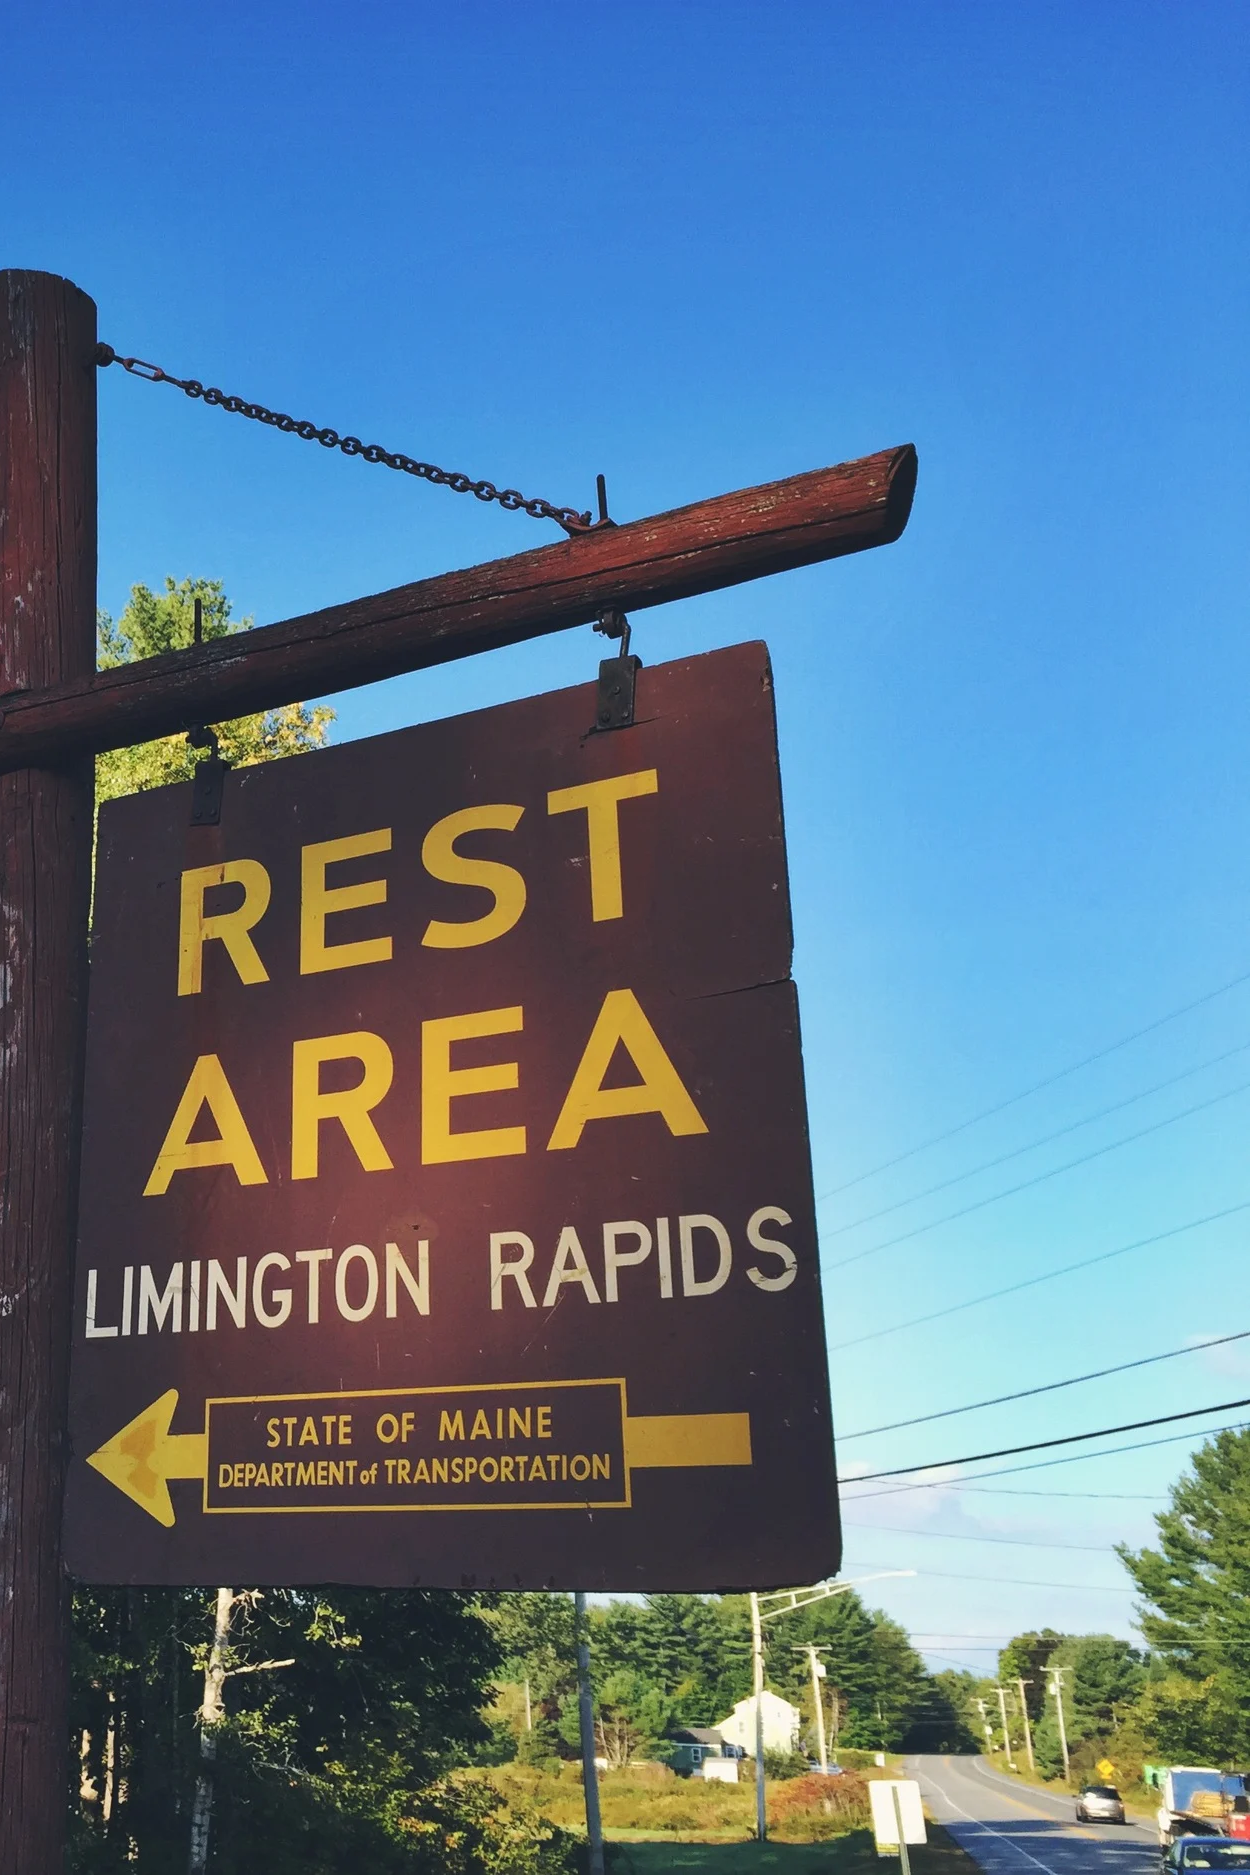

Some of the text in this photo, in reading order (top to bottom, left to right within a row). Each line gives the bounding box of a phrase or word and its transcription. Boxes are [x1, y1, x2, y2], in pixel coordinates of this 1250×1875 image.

[177, 768, 659, 997] REST
[142, 988, 709, 1197] AREA
[85, 1206, 798, 1338] LIMINGTON RAPIDS
[219, 1454, 611, 1488] DEPARTMENT of TRANSPORTATION
[266, 1406, 552, 1448] STATE OF MAINE
